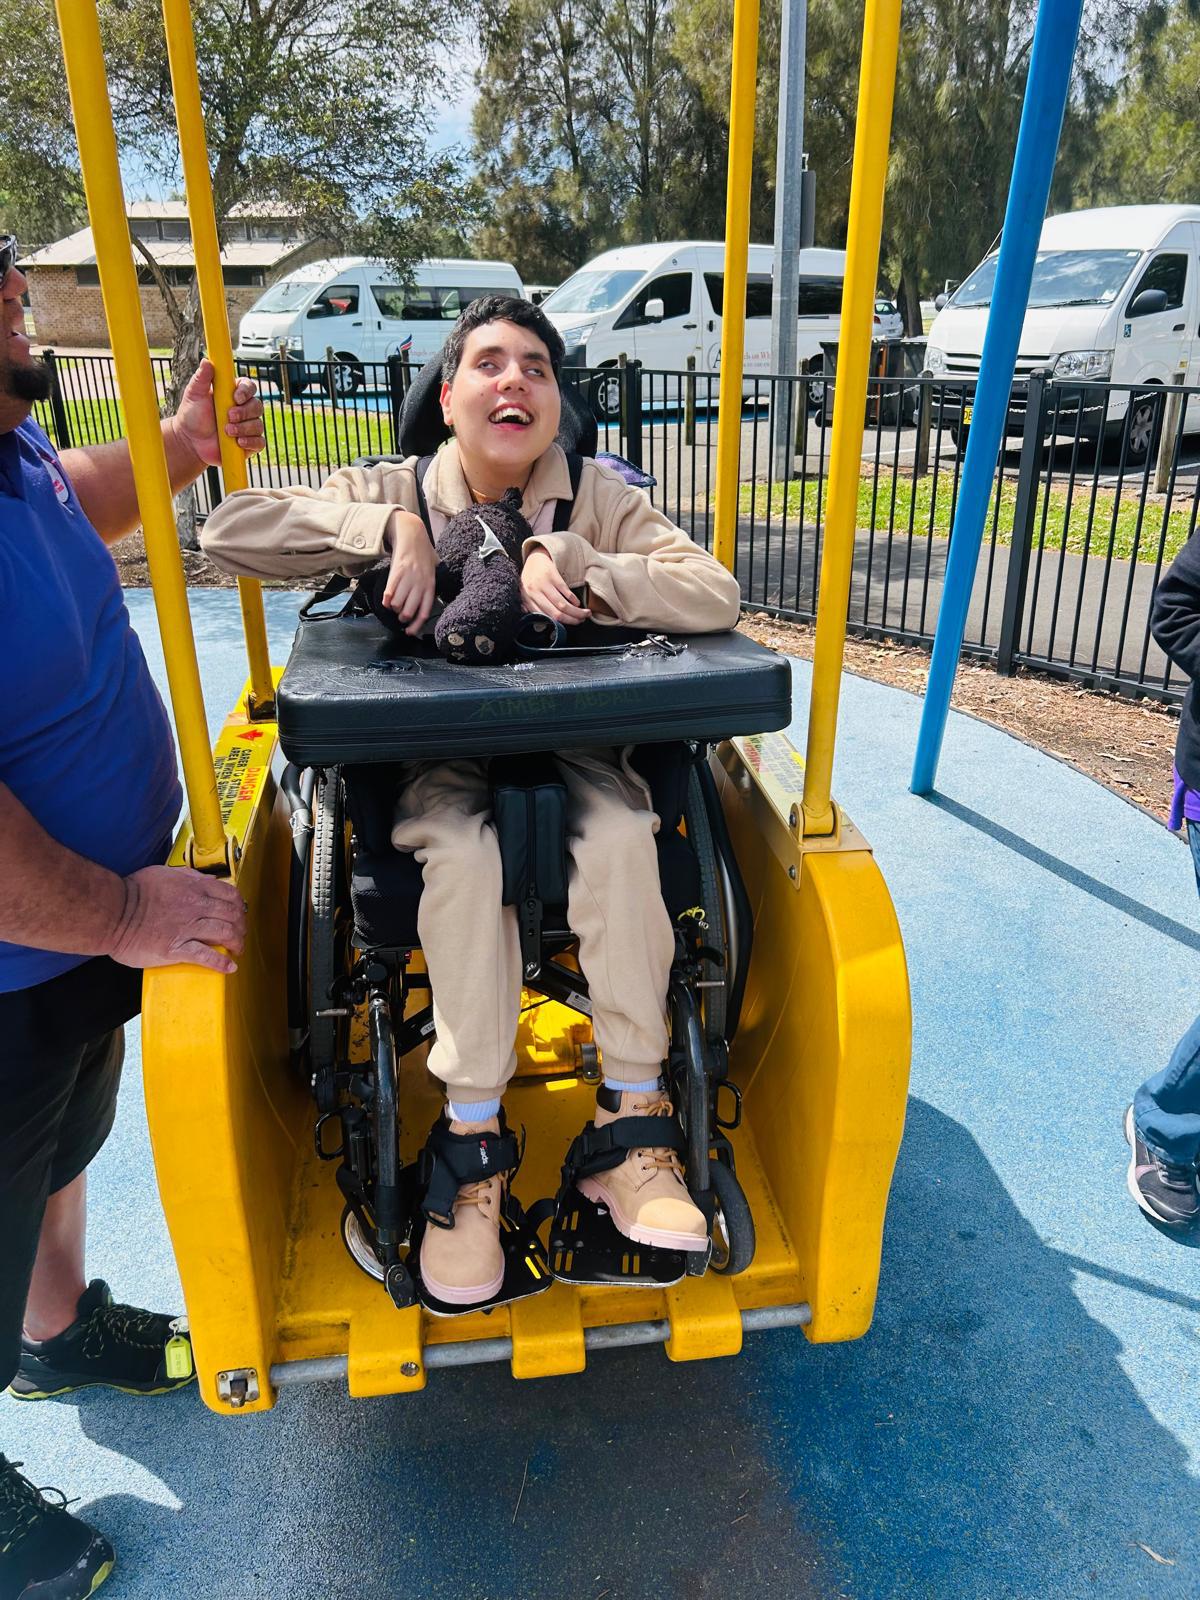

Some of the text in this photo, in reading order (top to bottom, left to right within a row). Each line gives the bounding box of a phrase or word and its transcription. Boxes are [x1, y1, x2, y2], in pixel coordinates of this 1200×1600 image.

[228, 746, 241, 761] AREA
[237, 749, 252, 768] CARER
[220, 762, 236, 779] WHEN
[233, 769, 245, 777] TO
[225, 779, 241, 799] STAND
[239, 767, 261, 801] DANGER
[222, 800, 235, 808] IN
